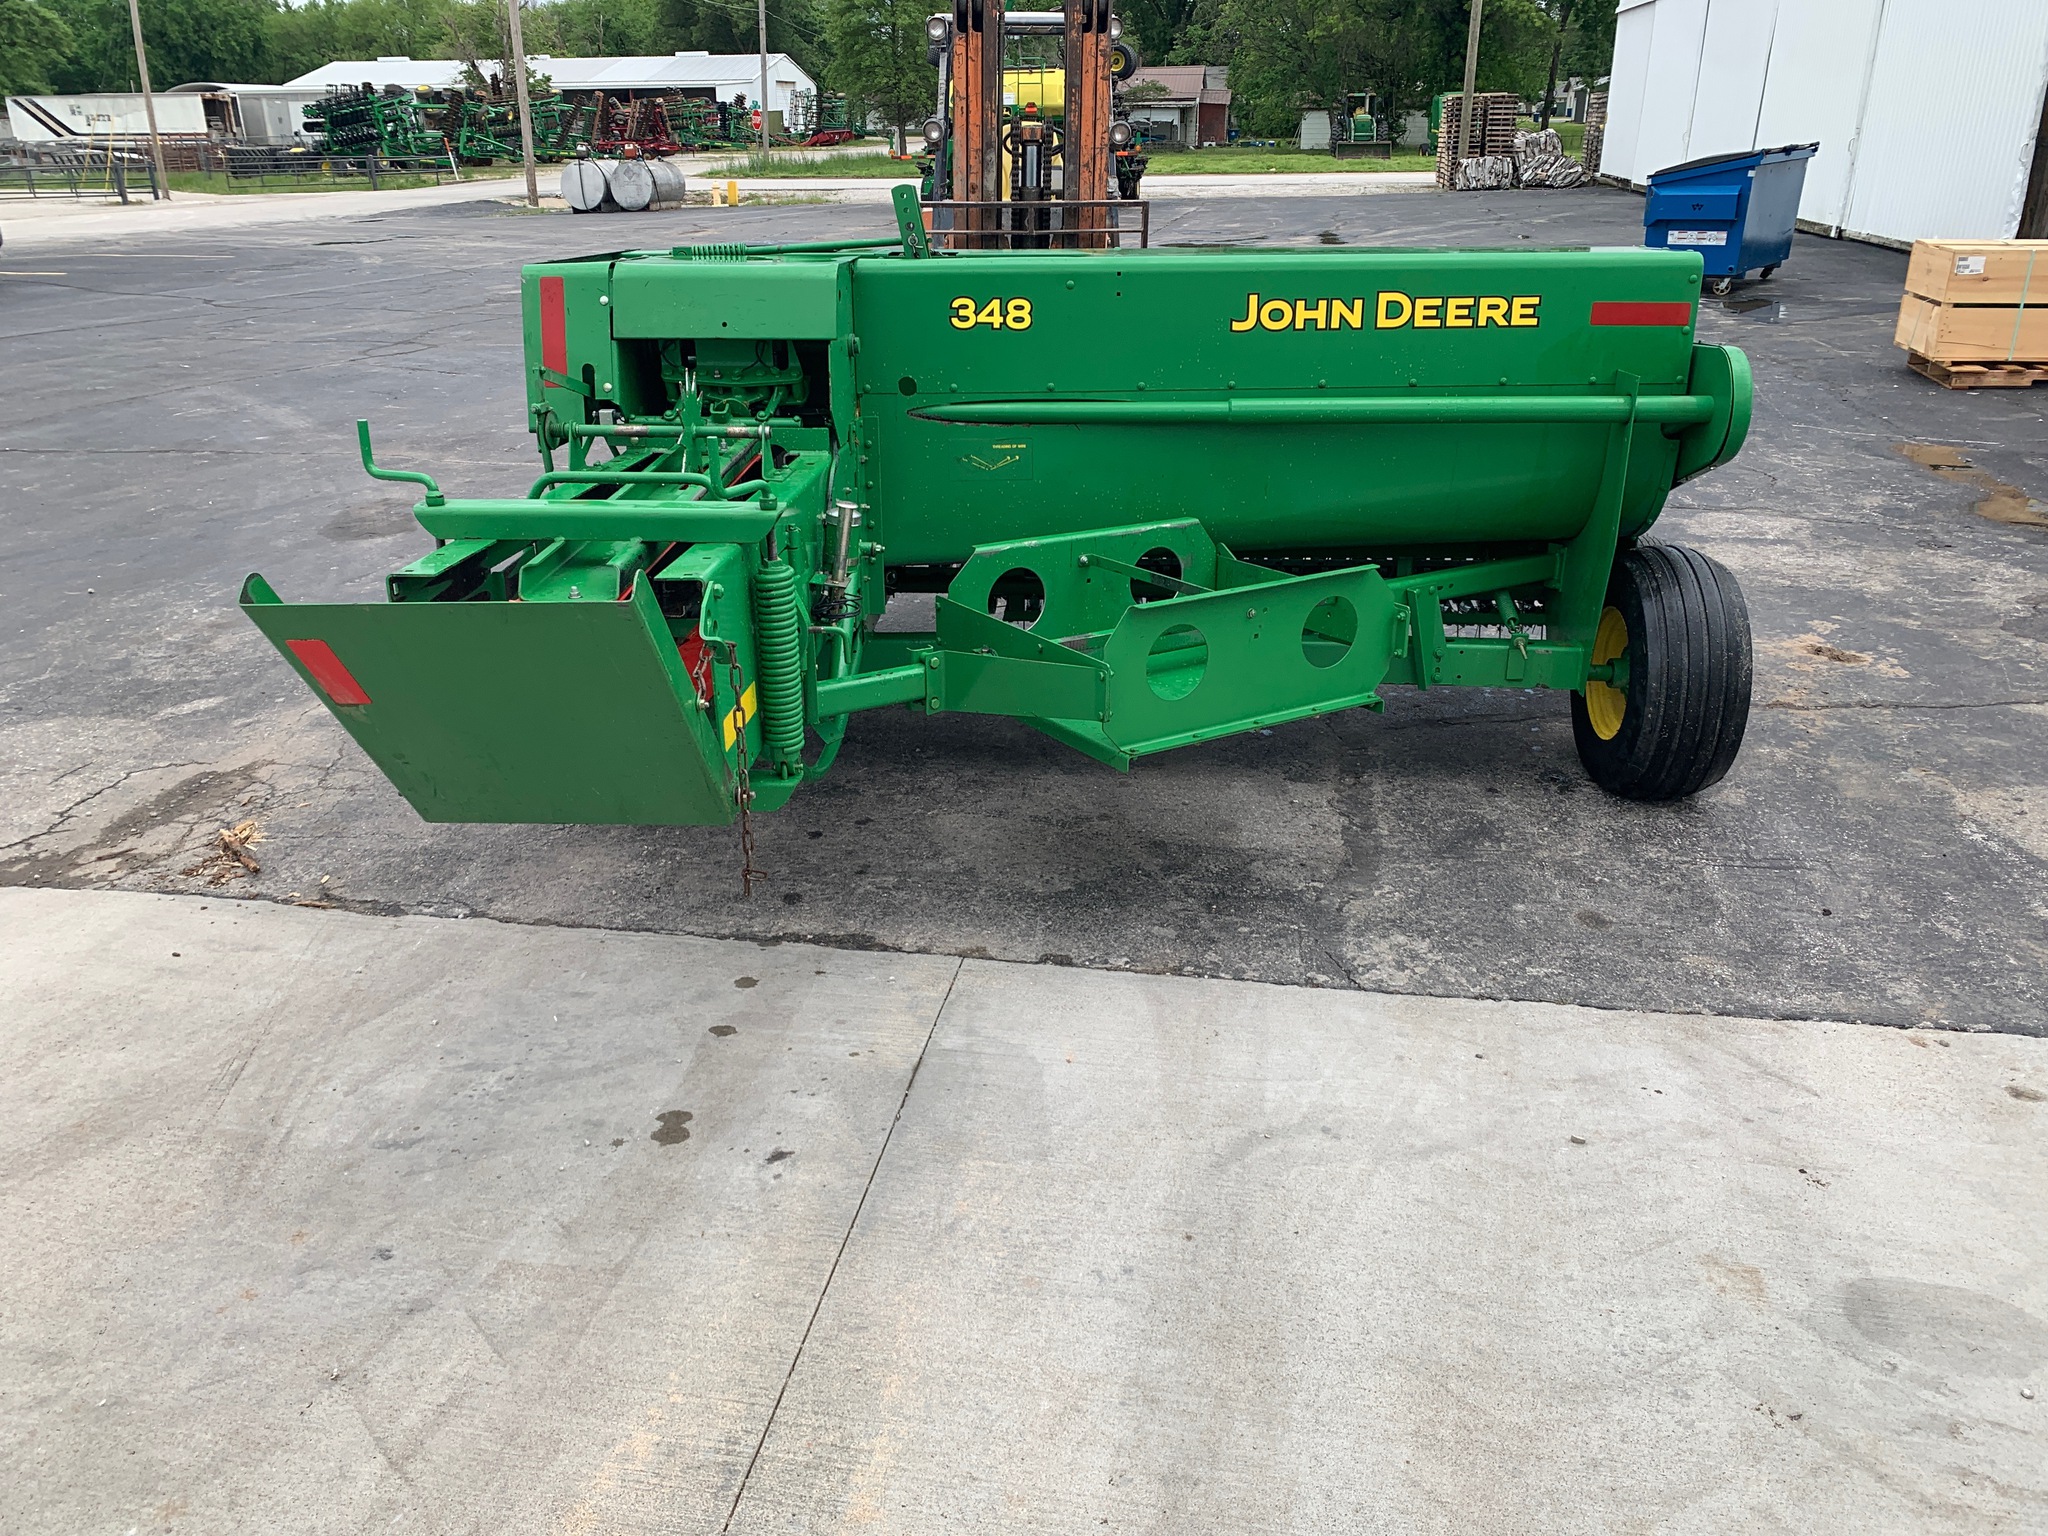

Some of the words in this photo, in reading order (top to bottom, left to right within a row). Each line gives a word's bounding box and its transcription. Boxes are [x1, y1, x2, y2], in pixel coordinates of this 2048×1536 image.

[949, 296, 1034, 332] 348
[1230, 292, 1366, 332] JOHN
[1375, 290, 1542, 329] DEERE
